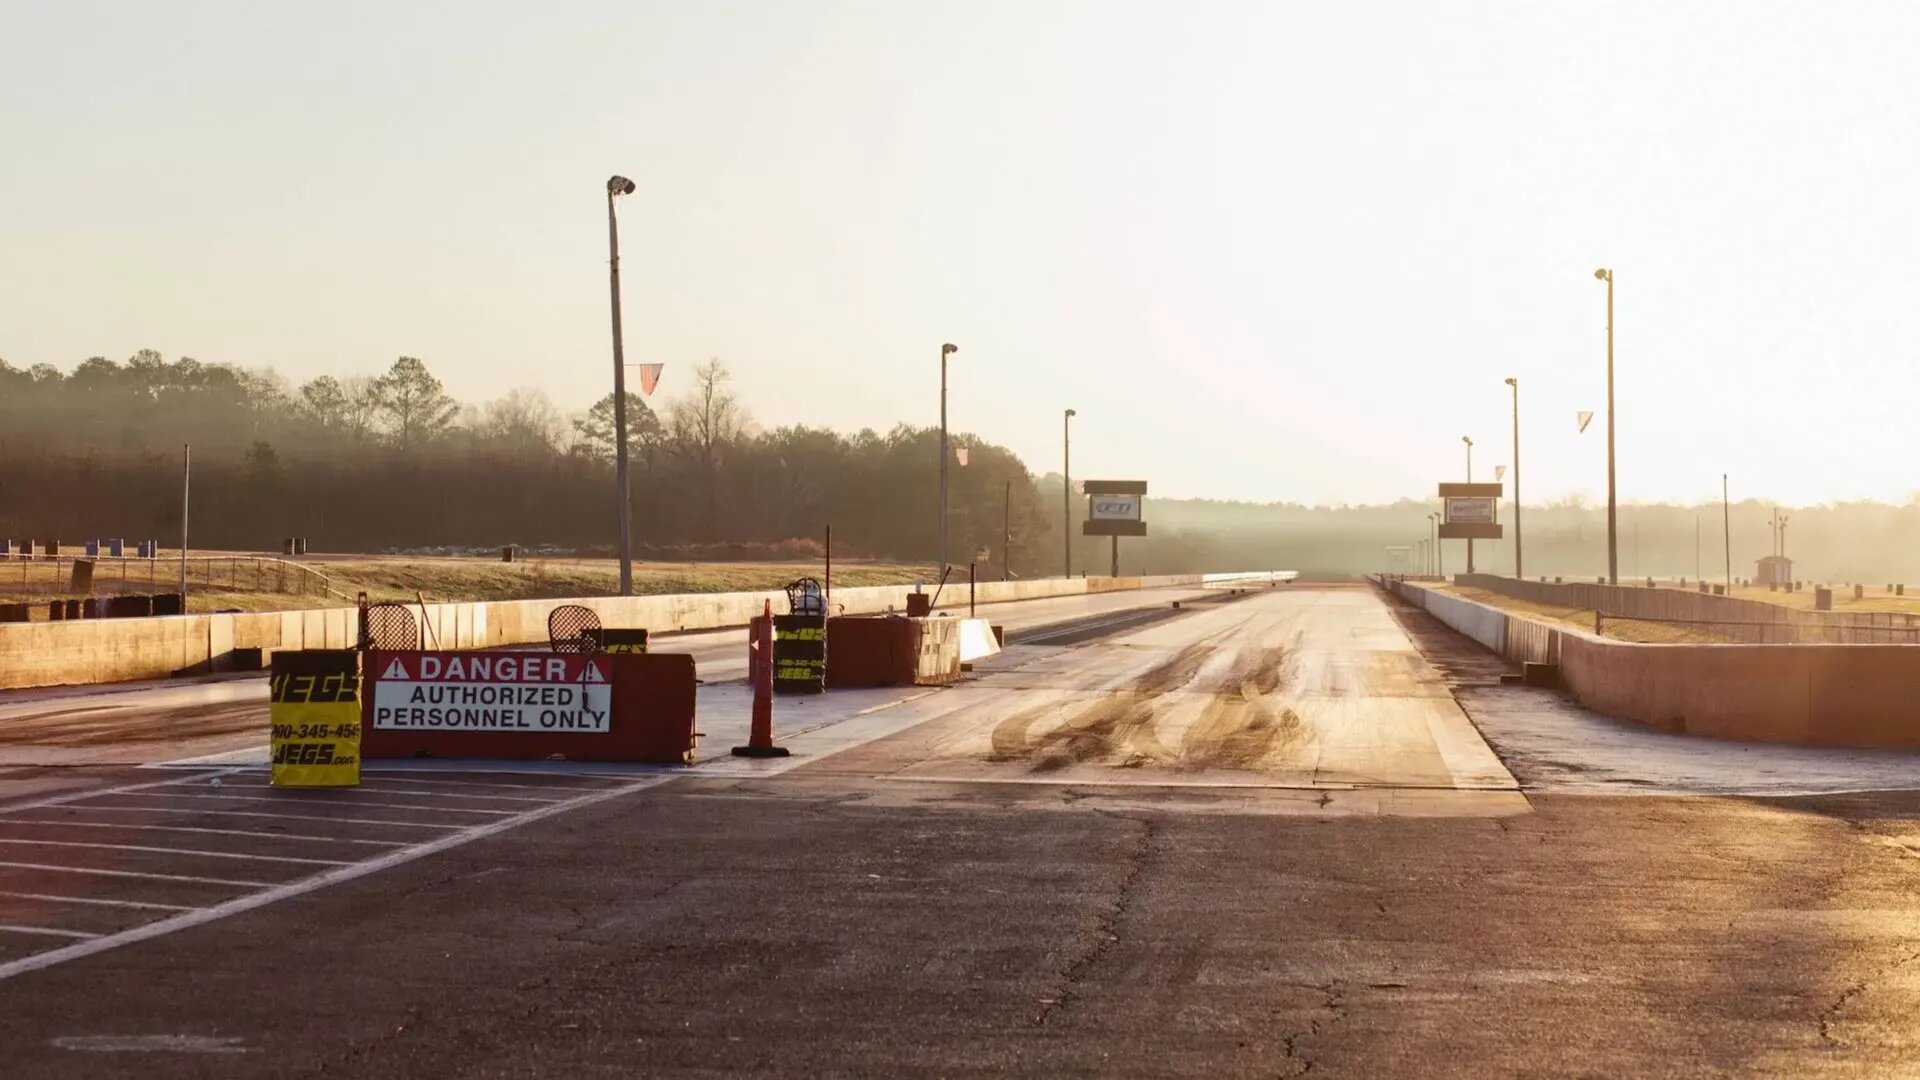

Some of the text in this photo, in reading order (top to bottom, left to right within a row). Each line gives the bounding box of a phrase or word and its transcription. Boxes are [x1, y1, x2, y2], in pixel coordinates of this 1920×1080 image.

[420, 655, 566, 681] DANGER
[410, 685, 573, 706] AUTHORIZED
[377, 707, 606, 729] PERSONNEL ONLY
